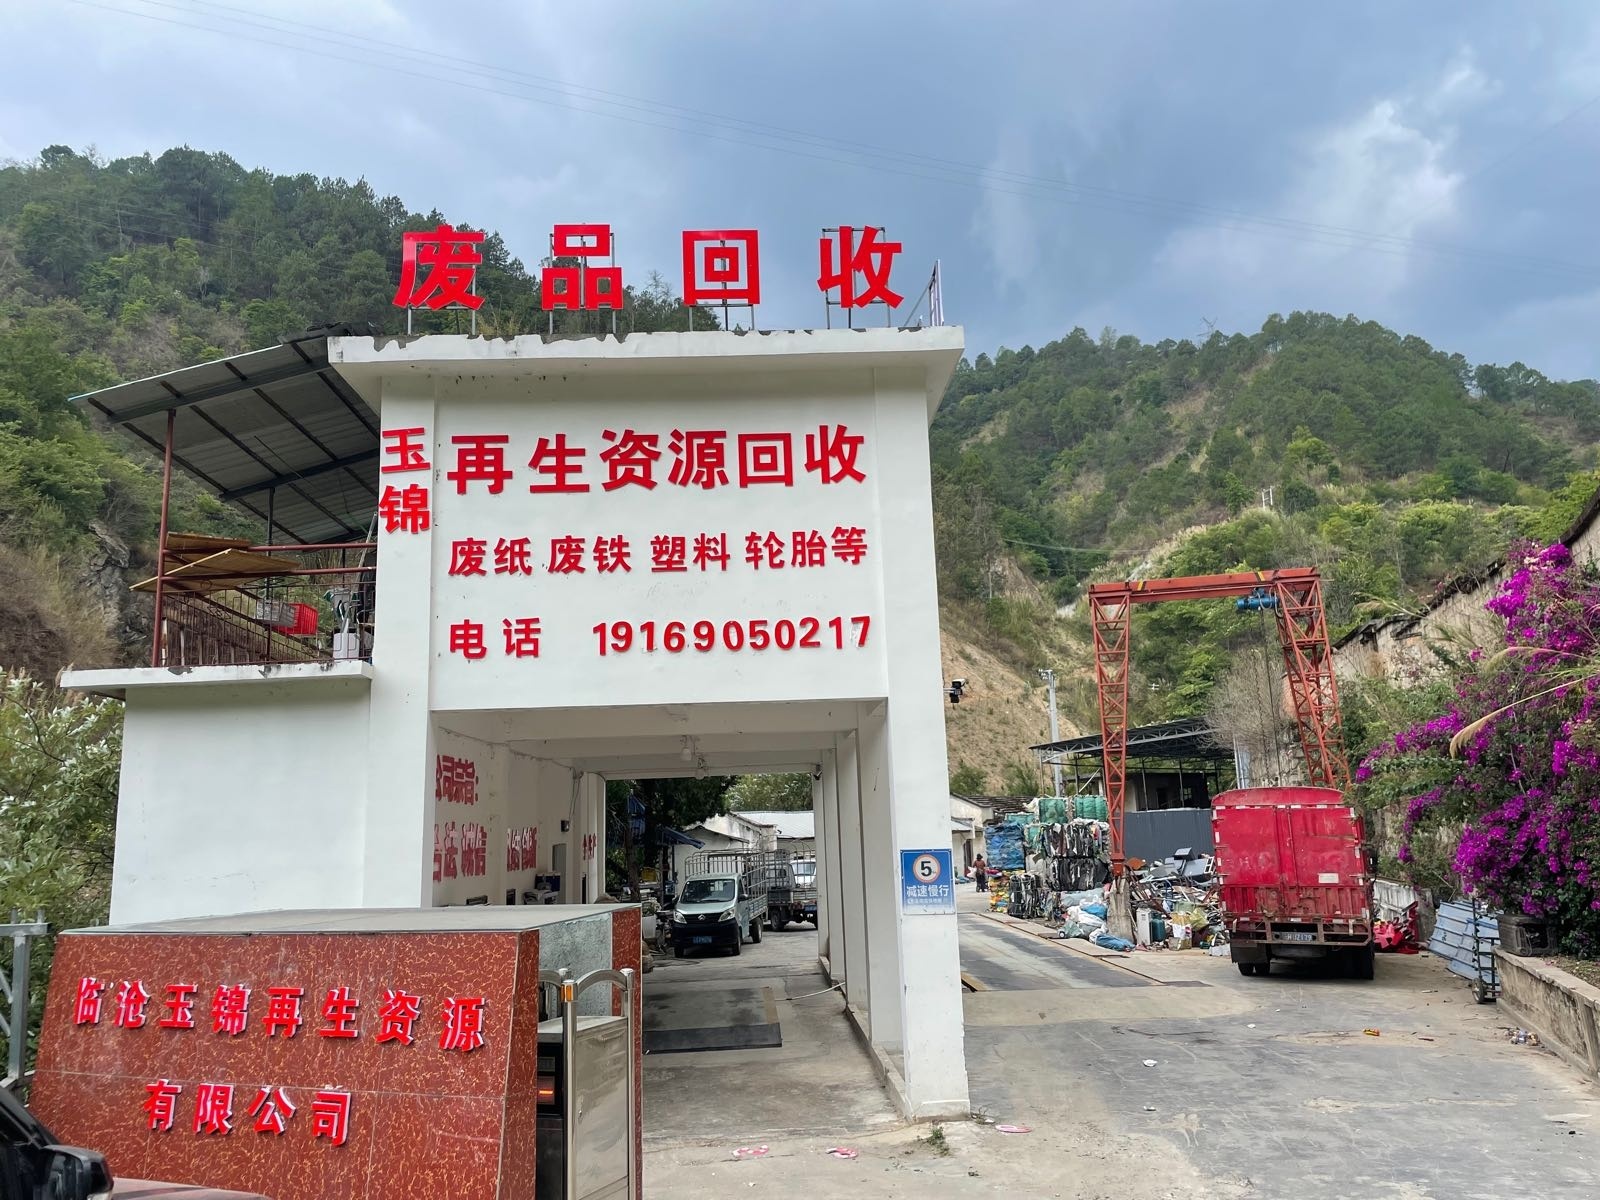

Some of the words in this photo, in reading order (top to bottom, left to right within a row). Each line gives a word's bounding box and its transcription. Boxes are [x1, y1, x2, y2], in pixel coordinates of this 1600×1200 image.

[393, 224, 903, 311] 废品回收
[378, 427, 432, 533] 玉锦
[447, 425, 866, 495] 再生资源回收
[449, 537, 532, 576] 废纸
[548, 535, 631, 574] 废铁
[652, 533, 731, 572] 塑料
[745, 526, 867, 569] 轮胎等
[450, 617, 541, 659] 电话
[593, 616, 871, 656] 19169050217
[907, 885, 949, 897] 减速慢行
[921, 861, 932, 876] 5
[75, 977, 485, 1052] 临沧玉锦再生资源
[143, 1078, 350, 1147] 有限公司
